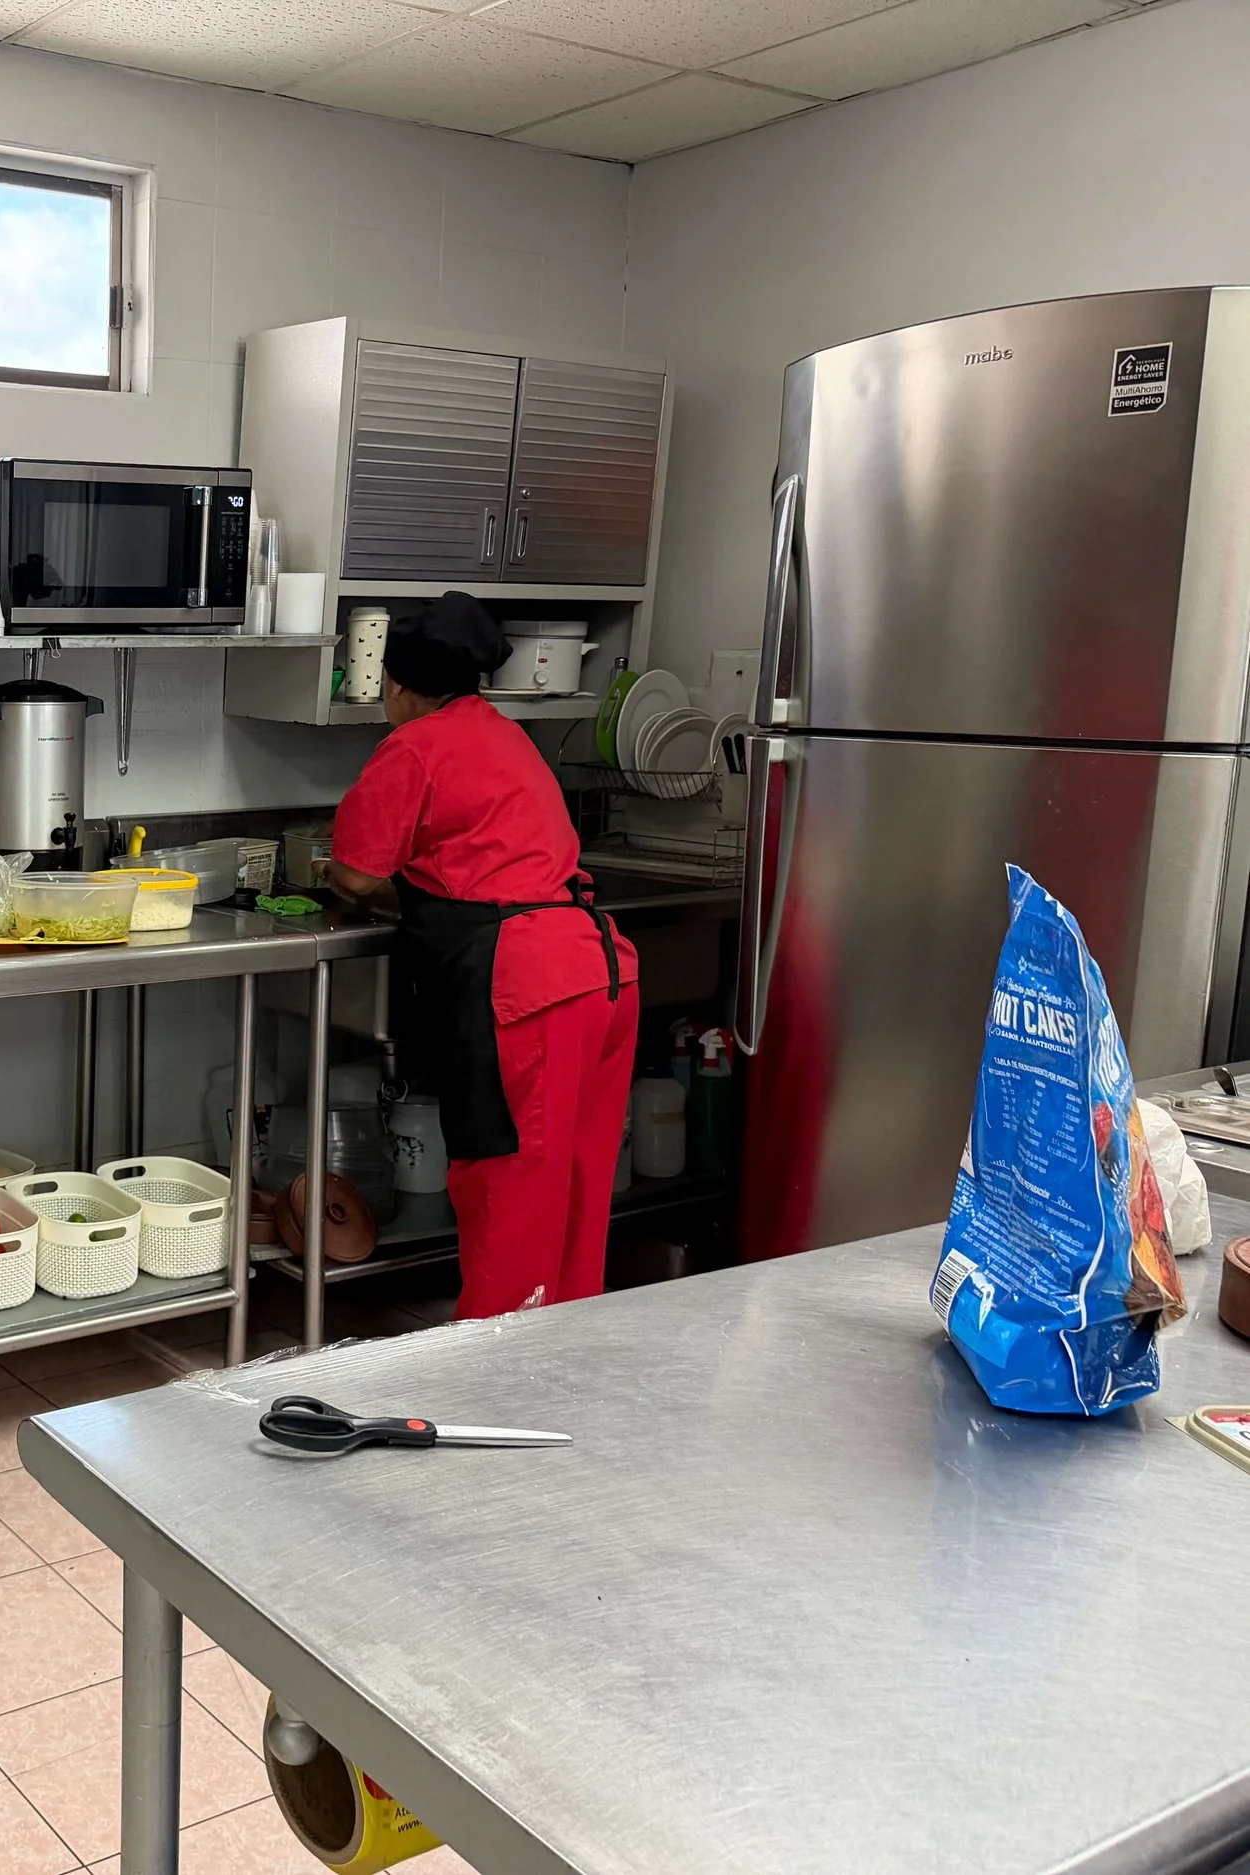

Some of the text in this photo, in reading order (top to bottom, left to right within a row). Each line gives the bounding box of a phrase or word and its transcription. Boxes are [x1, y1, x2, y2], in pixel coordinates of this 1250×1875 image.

[964, 346, 1013, 366] mabe
[1135, 363, 1165, 373] HOME
[1143, 371, 1164, 379] SAVER
[1115, 385, 1163, 396] MultiAhorro
[1114, 396, 1162, 408] Energético
[993, 990, 1077, 1049] HOT CAKES
[1001, 1030, 1019, 1042] SABOR
[1026, 1037, 1071, 1056] MANTEQUILLA
